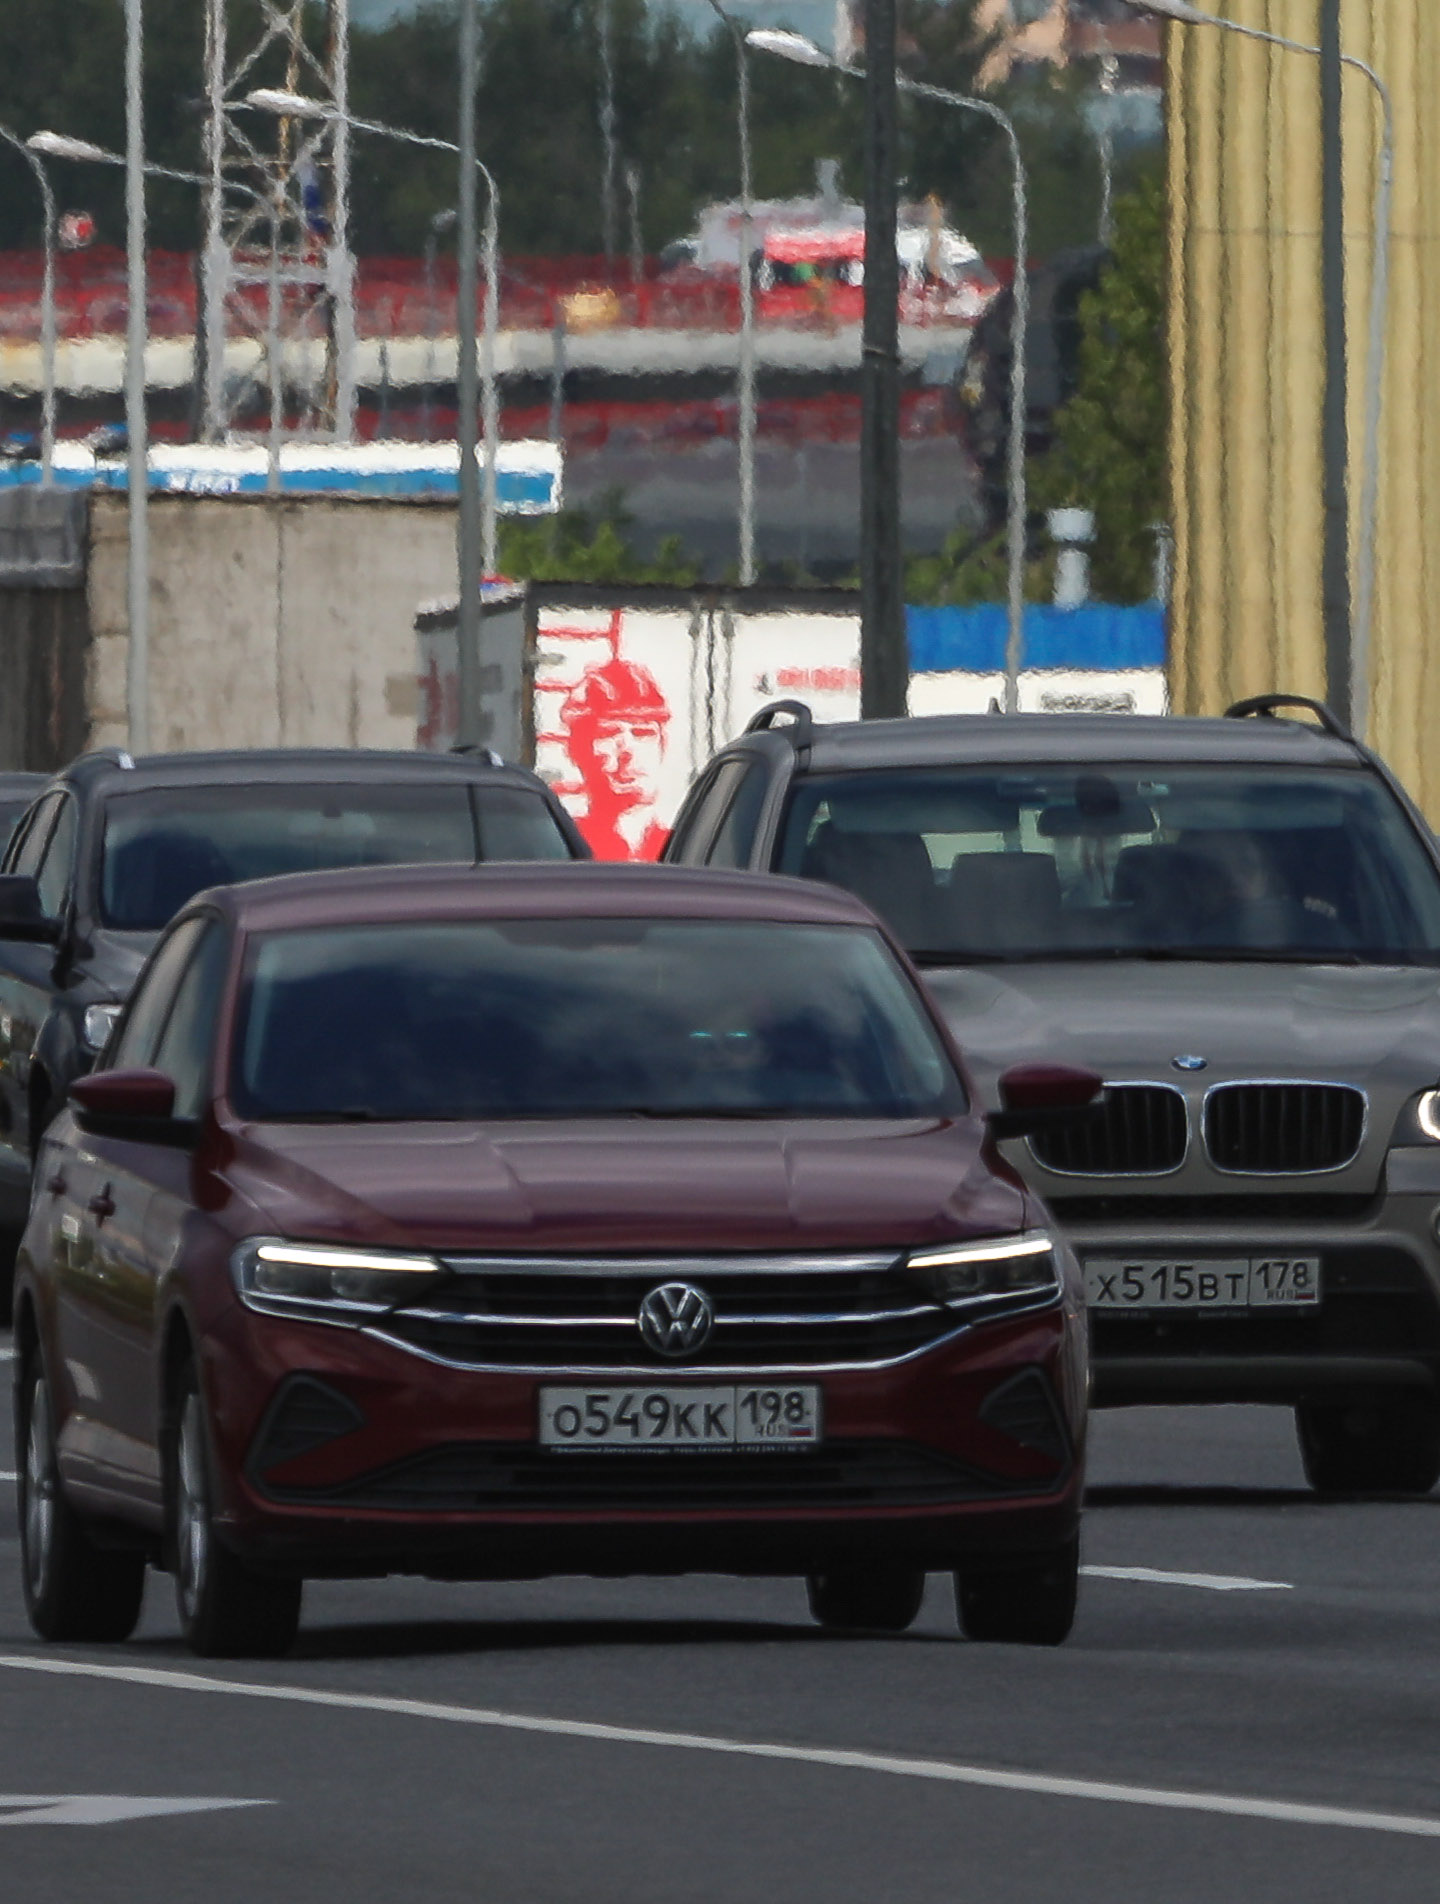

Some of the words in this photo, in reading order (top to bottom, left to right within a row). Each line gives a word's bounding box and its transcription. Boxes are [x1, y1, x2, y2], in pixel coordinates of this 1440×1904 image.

[1096, 1265, 1245, 1301] Х515ВТ
[1255, 1261, 1308, 1290] 178
[553, 1393, 728, 1439] О549КК
[740, 1390, 805, 1425] 198
